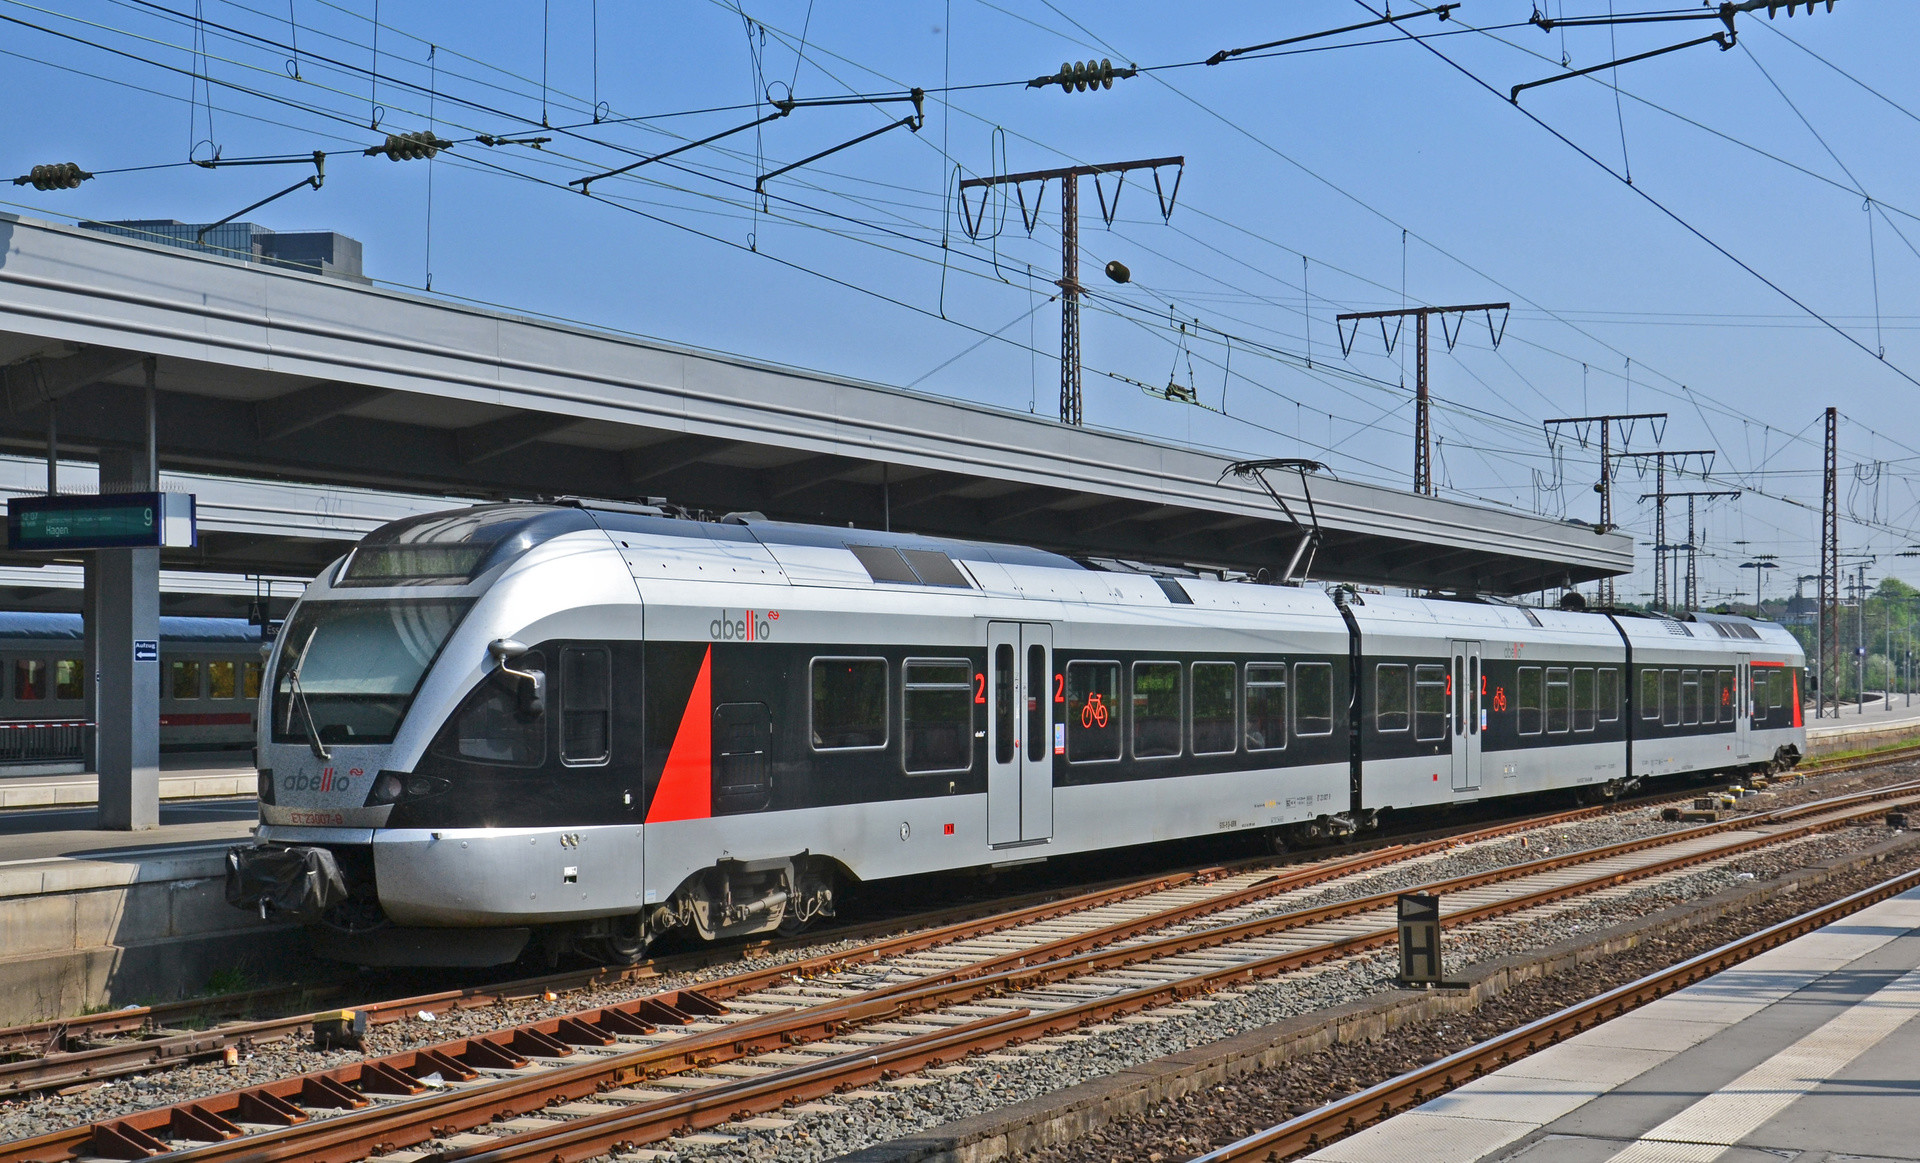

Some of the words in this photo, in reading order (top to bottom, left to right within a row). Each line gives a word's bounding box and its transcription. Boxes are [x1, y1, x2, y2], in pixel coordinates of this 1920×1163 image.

[144, 507, 153, 527] 9
[46, 525, 69, 538] Hagen
[709, 608, 771, 642] abellio
[135, 642, 156, 650] Aufzug
[974, 673, 986, 704] 2
[1054, 673, 1065, 703] 2
[1446, 674, 1452, 696] 2
[1481, 675, 1487, 696] 2
[283, 767, 350, 792] abellio
[1403, 925, 1436, 977] H
